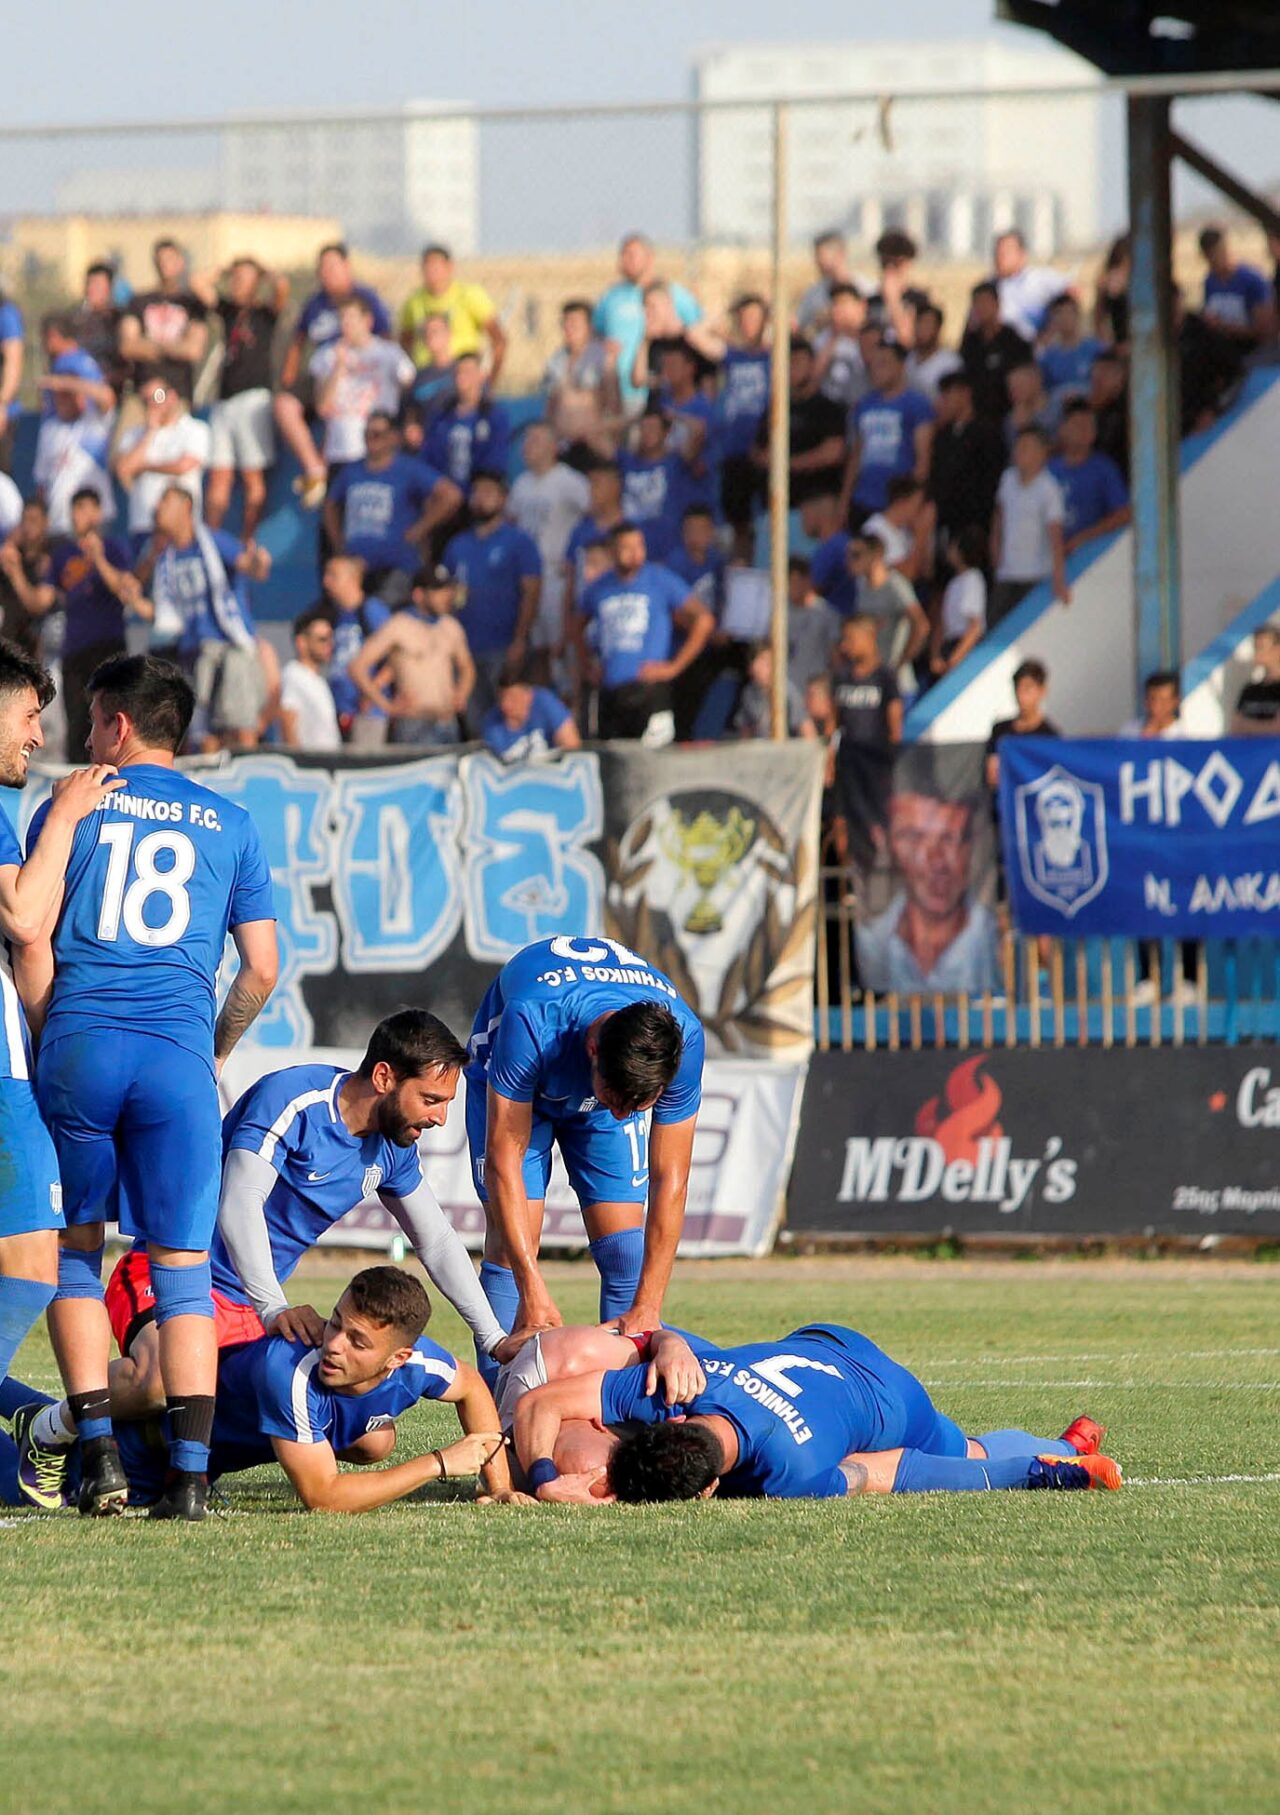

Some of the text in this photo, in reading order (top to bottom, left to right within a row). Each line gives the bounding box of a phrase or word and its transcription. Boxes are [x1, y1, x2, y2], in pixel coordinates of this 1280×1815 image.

[189, 804, 222, 831] F.C.
[97, 822, 196, 947] 18
[536, 966, 578, 987] F.C.
[837, 1136, 1078, 1213] McDelly's
[748, 1354, 846, 1399] 7
[733, 1369, 814, 1446] ETHNIKOS
